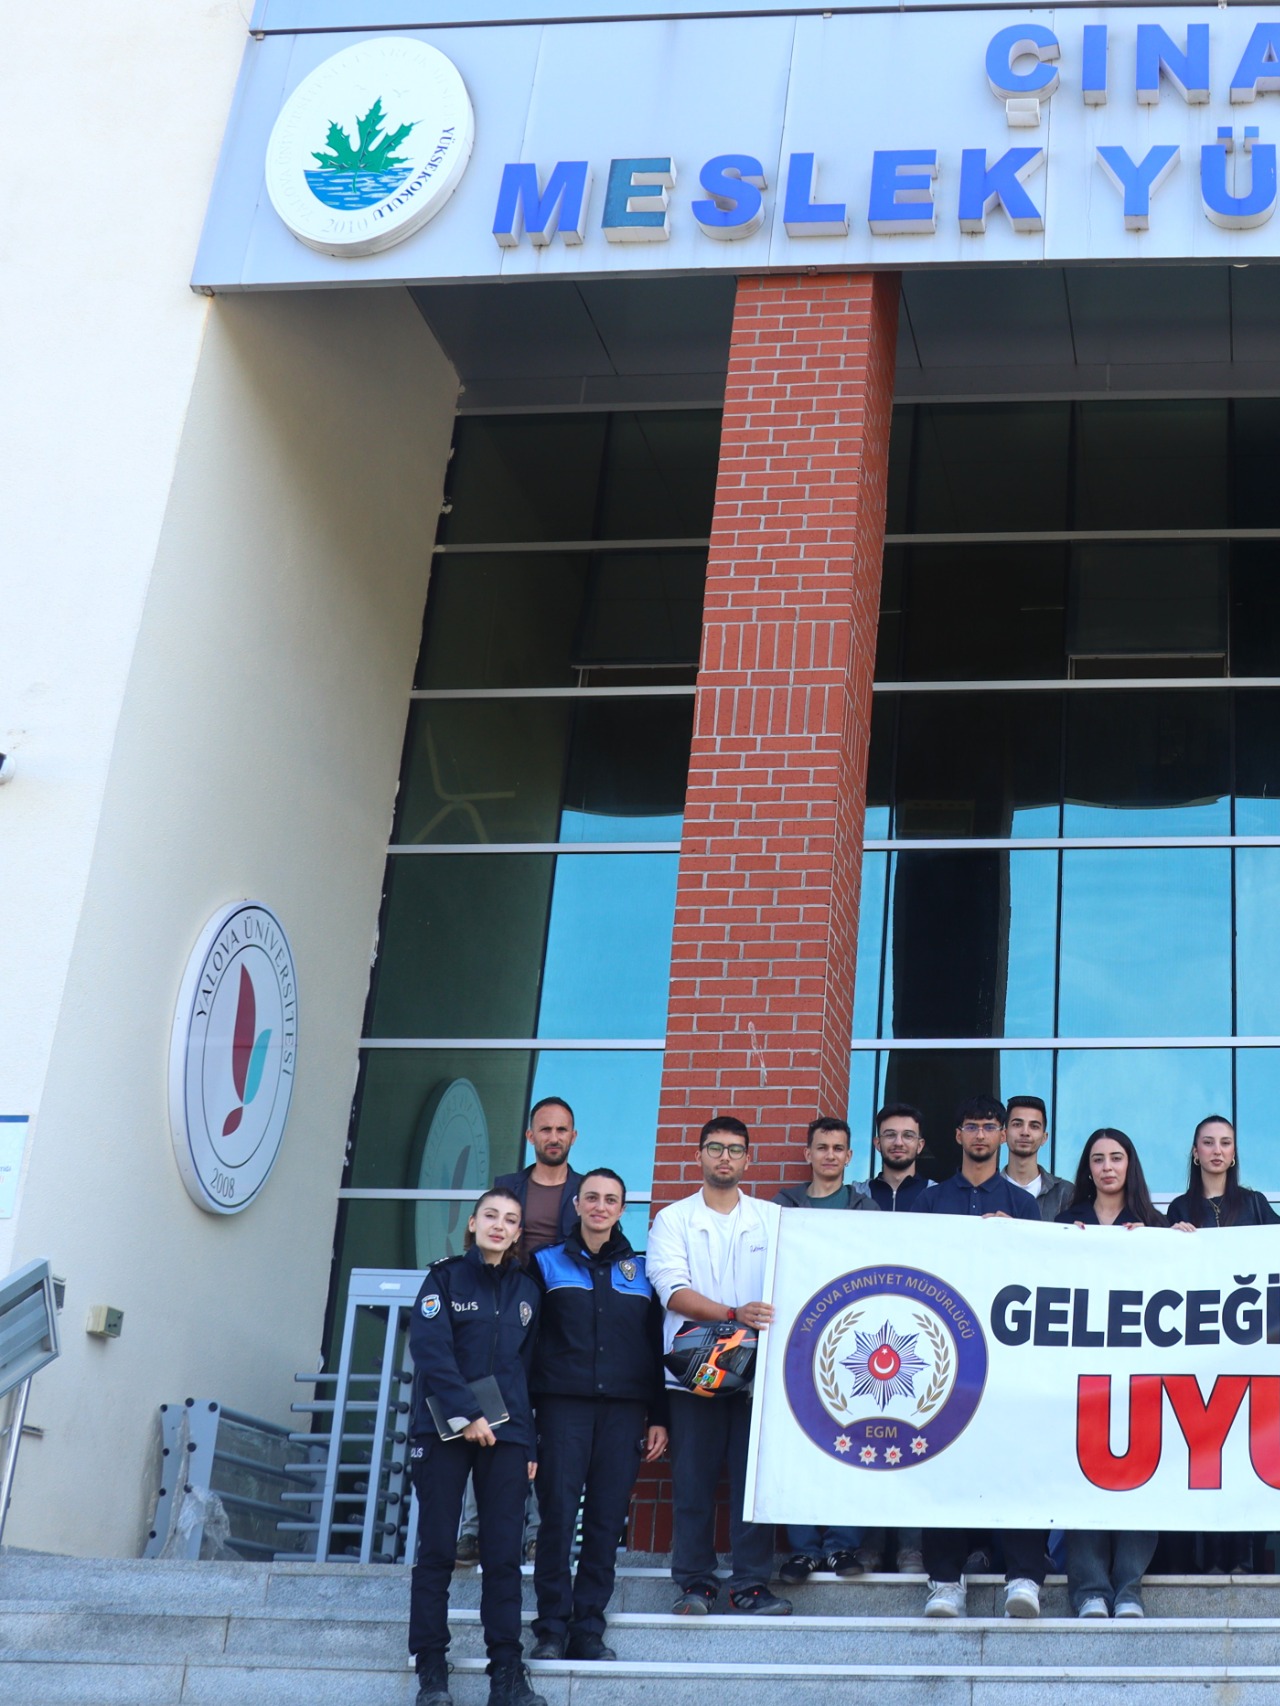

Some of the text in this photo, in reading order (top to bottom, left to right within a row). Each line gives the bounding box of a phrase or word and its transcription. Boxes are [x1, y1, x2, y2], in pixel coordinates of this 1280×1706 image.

[373, 127, 456, 220] YÜKSEKOKULU
[493, 147, 1043, 244] MESLEK
[196, 929, 240, 1019] YALOVA
[209, 1167, 236, 1199] 2008
[800, 1272, 976, 1341] YALOVA EMNİYET MÜDÜRLÜĞÜ
[865, 1425, 898, 1439] EGM
